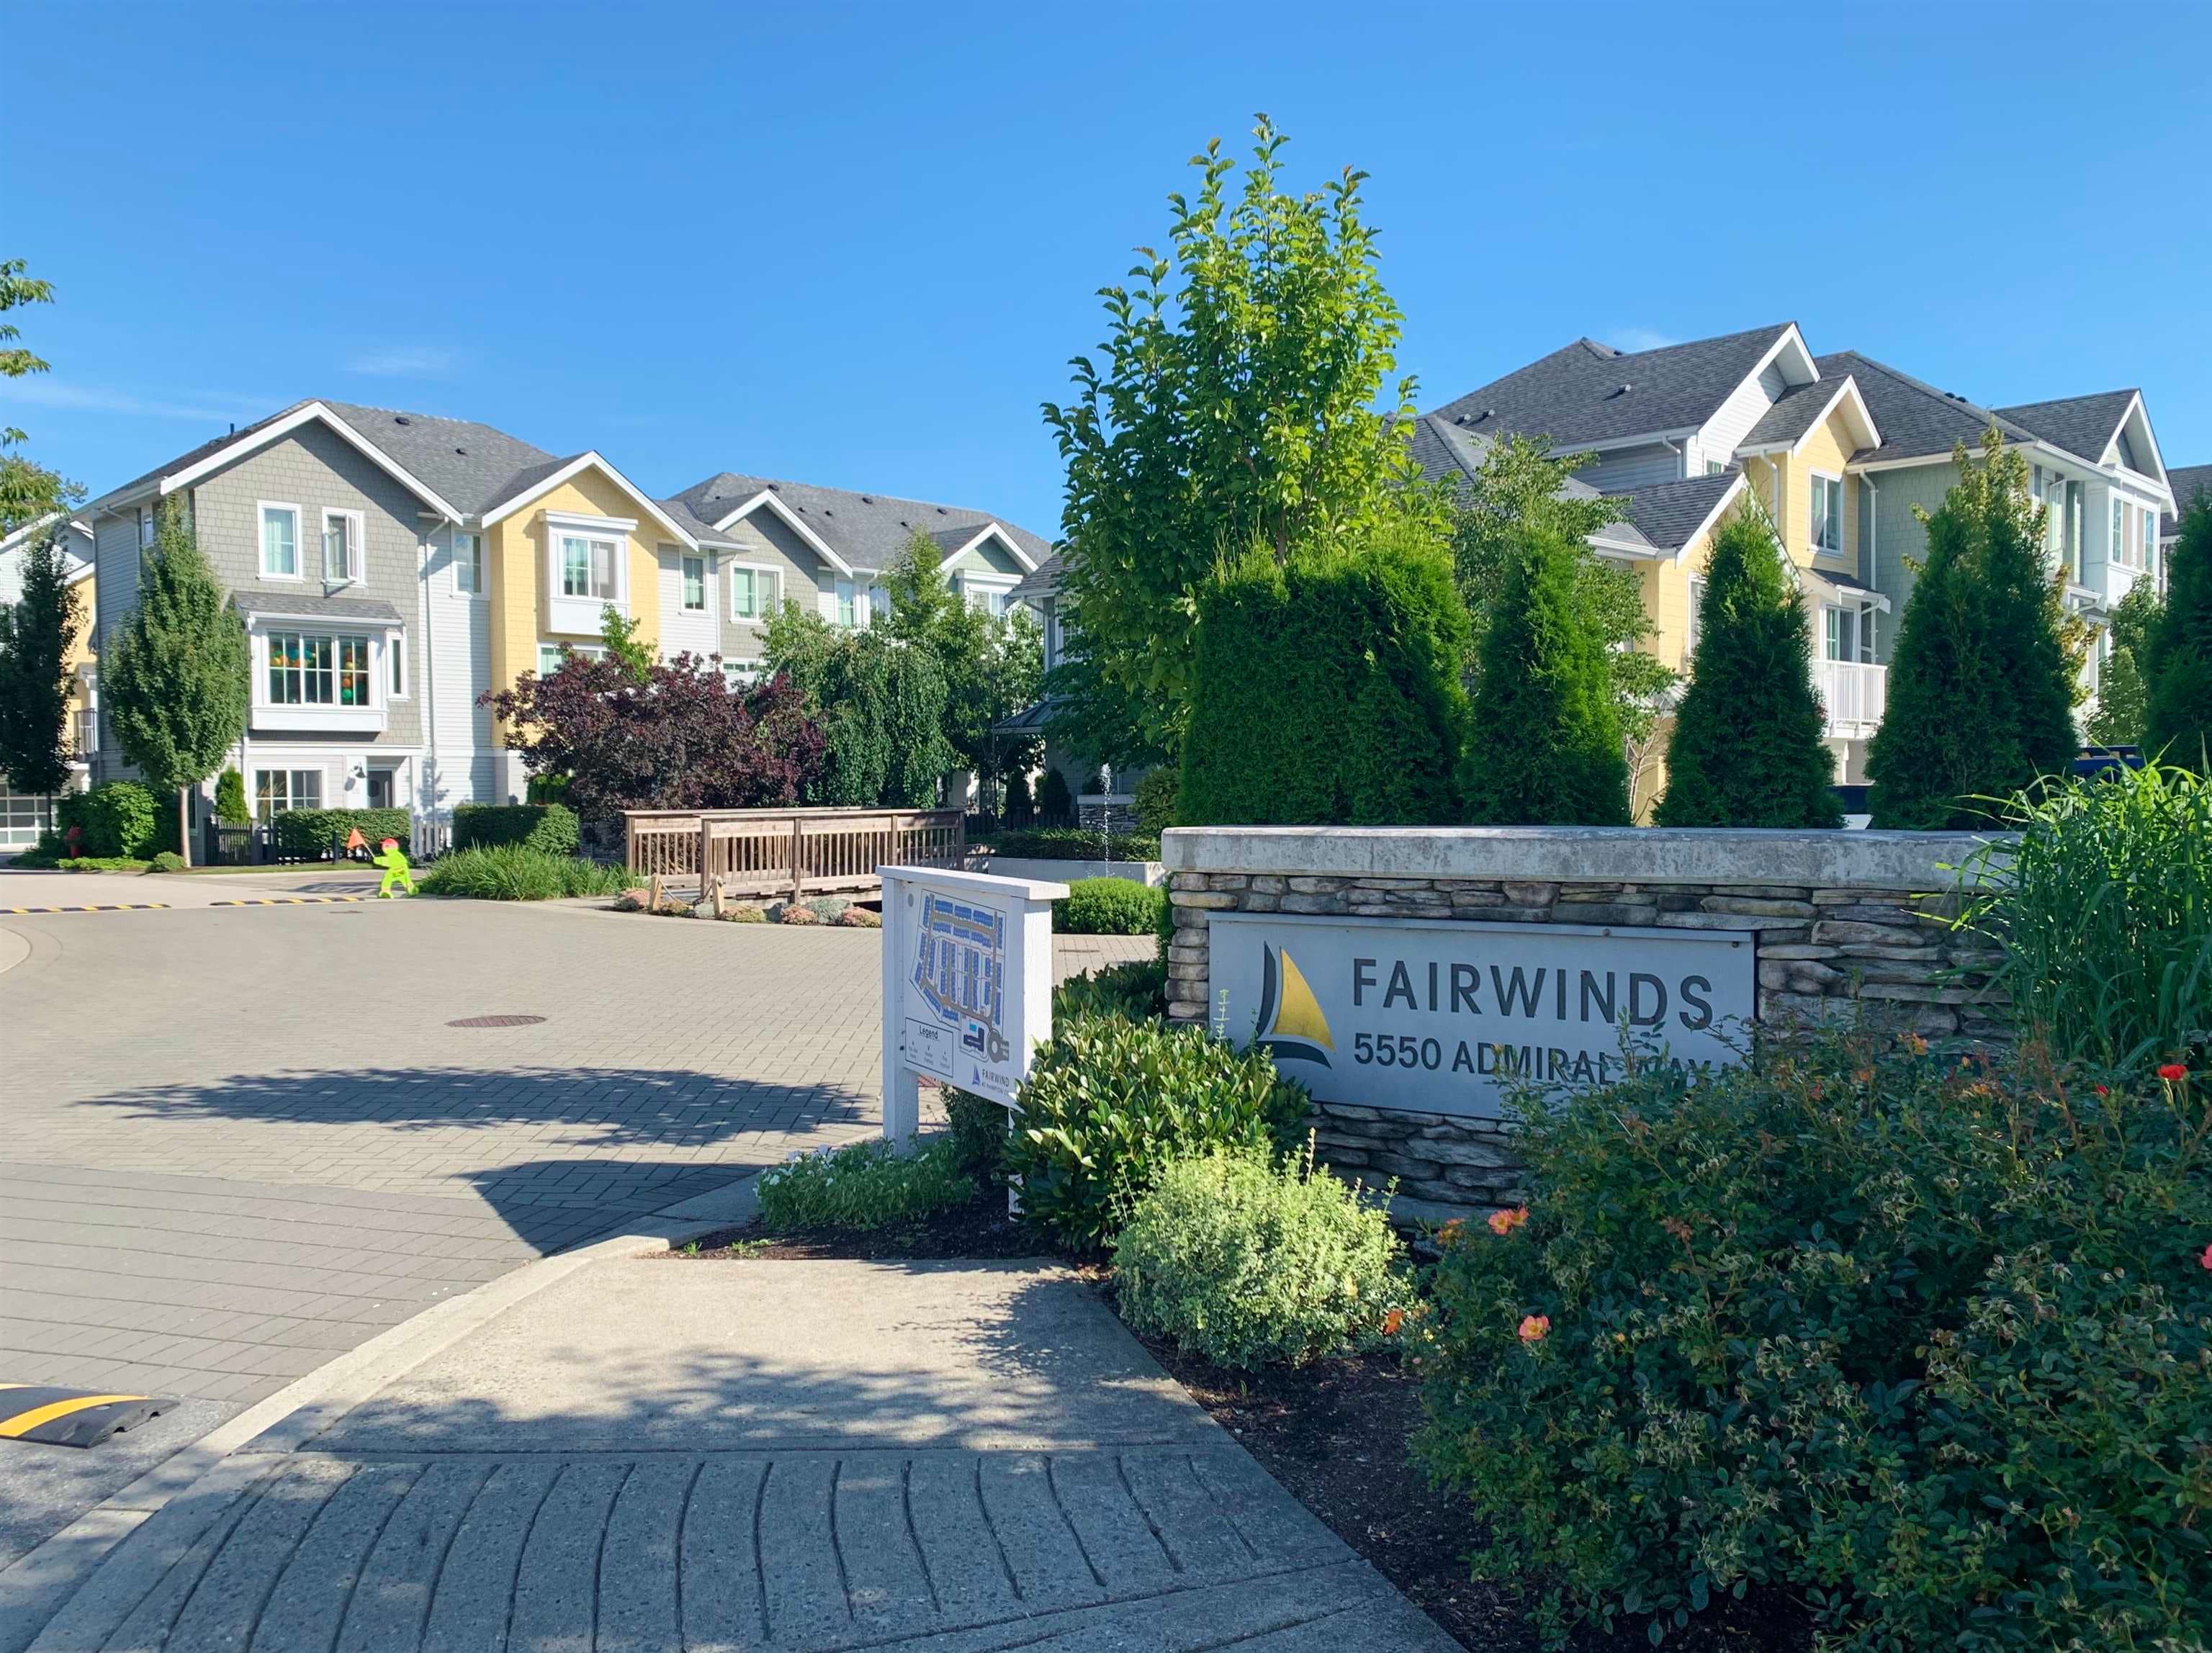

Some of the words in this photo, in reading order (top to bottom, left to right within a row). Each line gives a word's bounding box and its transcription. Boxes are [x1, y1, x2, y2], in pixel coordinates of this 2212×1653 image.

[1353, 958, 1713, 1030] FAIRWINDS
[919, 1024, 938, 1040] Legend
[1354, 1032, 1442, 1071] 5550
[1452, 1040, 1617, 1085] ADMIRAL
